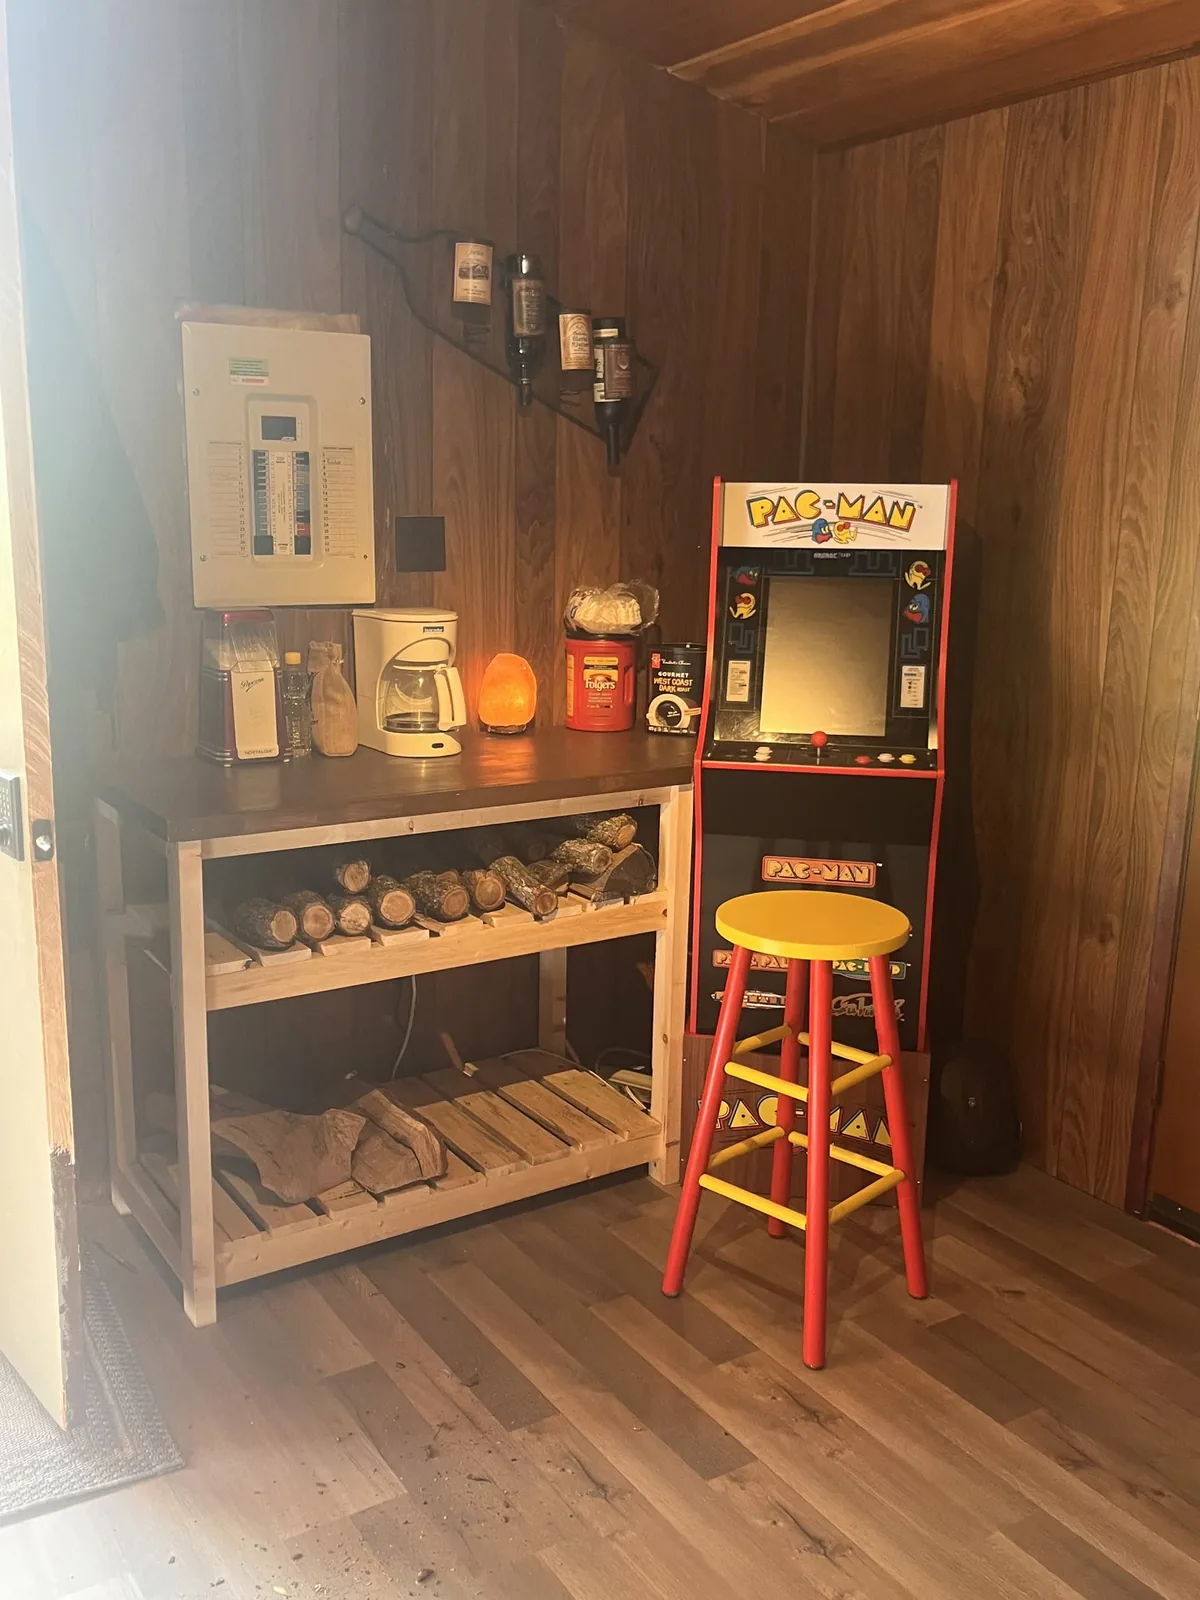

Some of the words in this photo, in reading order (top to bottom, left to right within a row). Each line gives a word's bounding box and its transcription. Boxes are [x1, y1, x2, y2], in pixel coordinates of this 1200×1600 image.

[746, 489, 916, 532] PAC-MAN
[585, 678, 616, 692] Folgers
[653, 677, 671, 685] WEST
[672, 678, 693, 687] COAST
[659, 684, 677, 693] DARK
[766, 859, 871, 883] PAC-MAN
